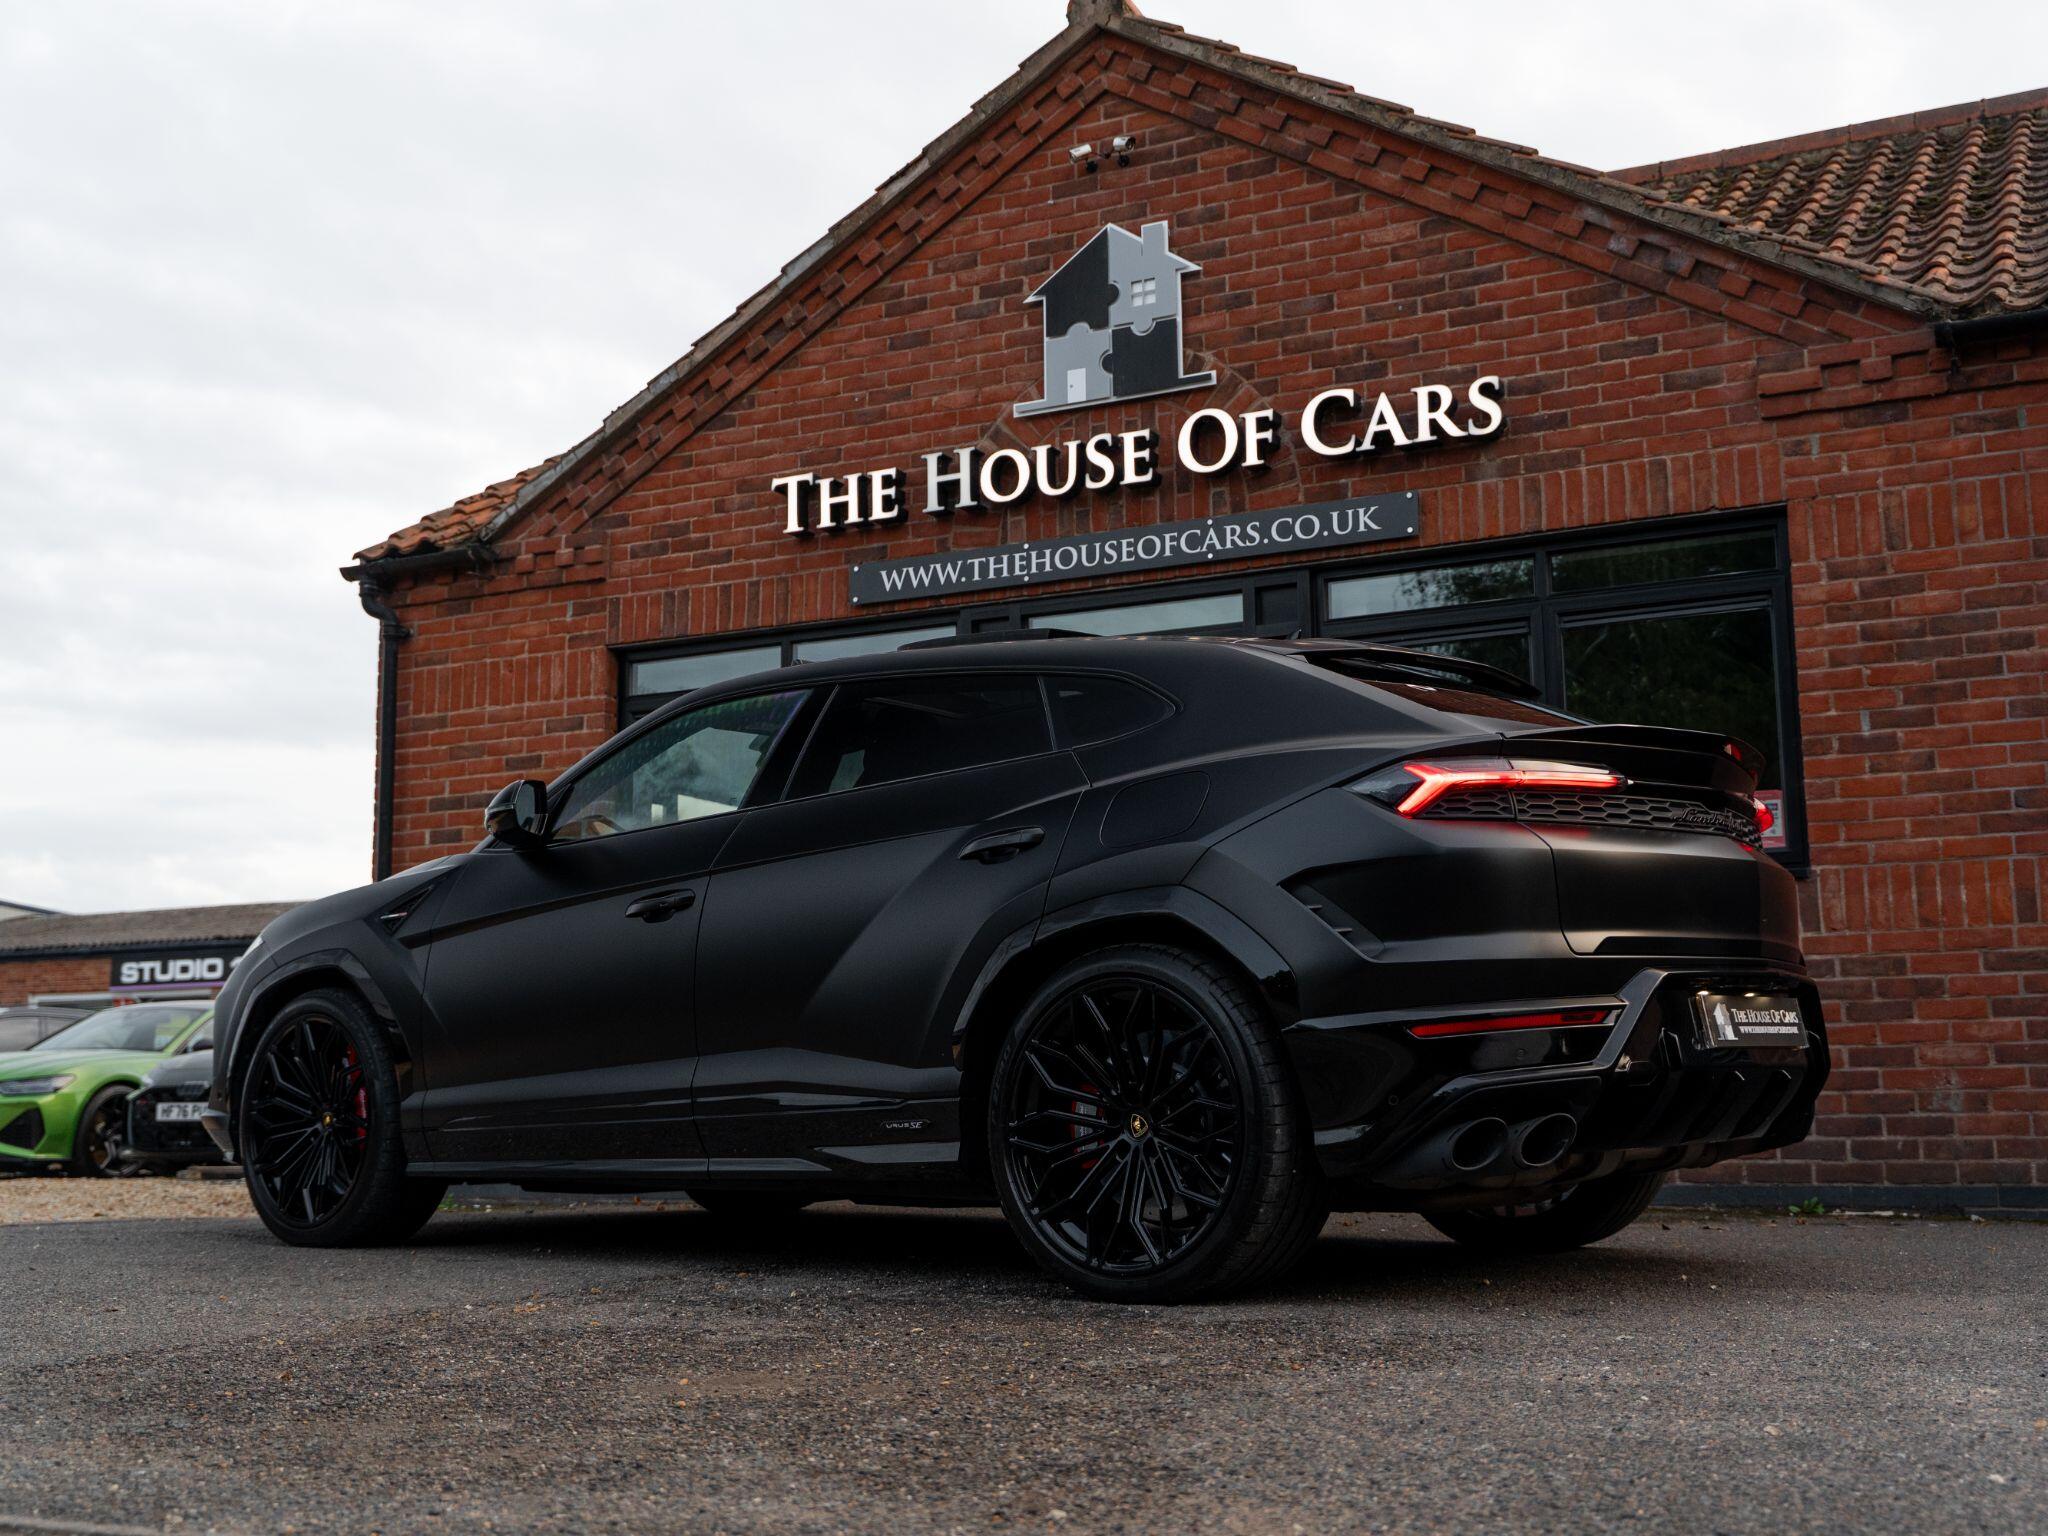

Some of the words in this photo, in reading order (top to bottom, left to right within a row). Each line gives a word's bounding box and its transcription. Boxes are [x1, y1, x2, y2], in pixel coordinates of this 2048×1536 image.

[771, 467, 899, 534] THE
[921, 427, 1153, 514] HOUSE
[1177, 408, 1274, 473] OF
[1301, 375, 1502, 456] CARS
[879, 505, 1382, 593] WWW.THEHOUSEOFCARS.CO.UK
[120, 957, 224, 984] STUDIO
[1731, 1009, 1748, 1023] THE
[1746, 1009, 1772, 1024] HOUSE
[1771, 1009, 1781, 1024] OF
